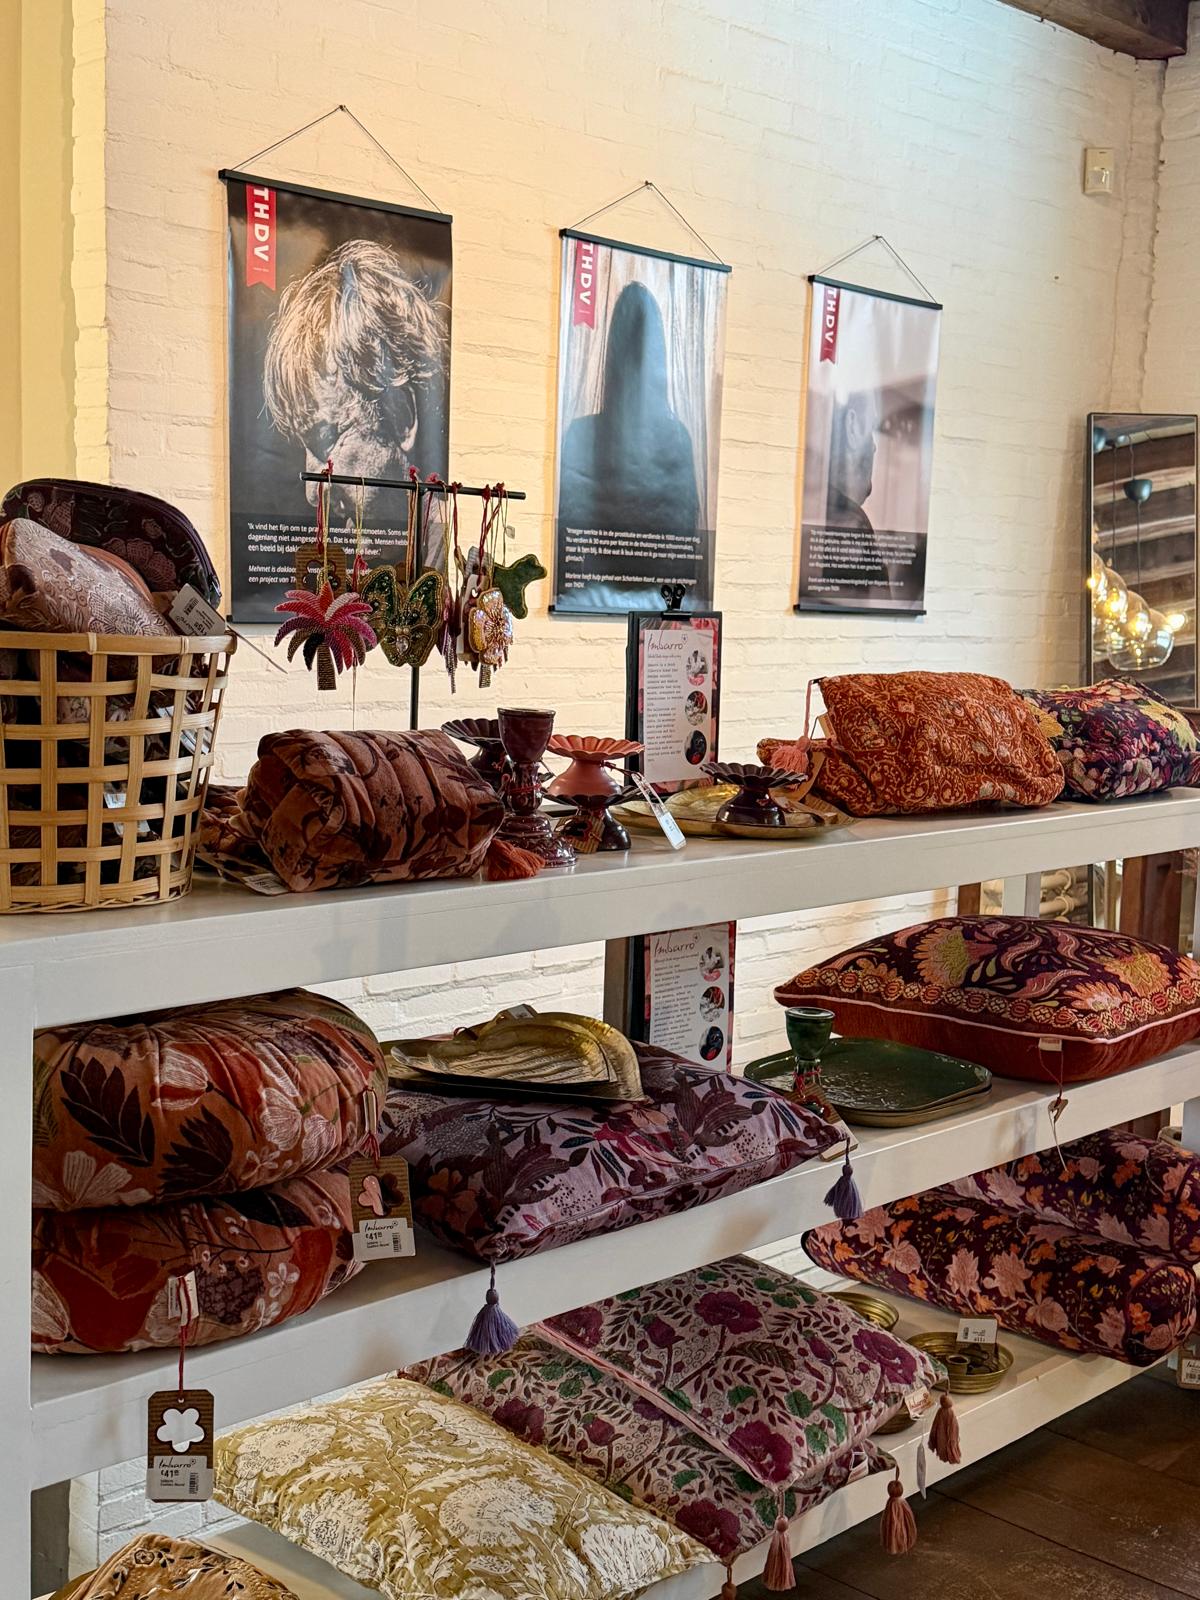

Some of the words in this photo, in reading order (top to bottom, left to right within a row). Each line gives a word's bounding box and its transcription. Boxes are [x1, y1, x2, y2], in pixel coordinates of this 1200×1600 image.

[254, 187, 269, 261] THDV
[580, 243, 593, 305] THDV
[825, 288, 836, 343] THDV
[248, 533, 277, 542] dagenlang
[280, 524, 289, 532] fijn
[260, 576, 278, 584] project
[648, 630, 683, 651] Imbarro
[654, 934, 694, 957] Imbarro
